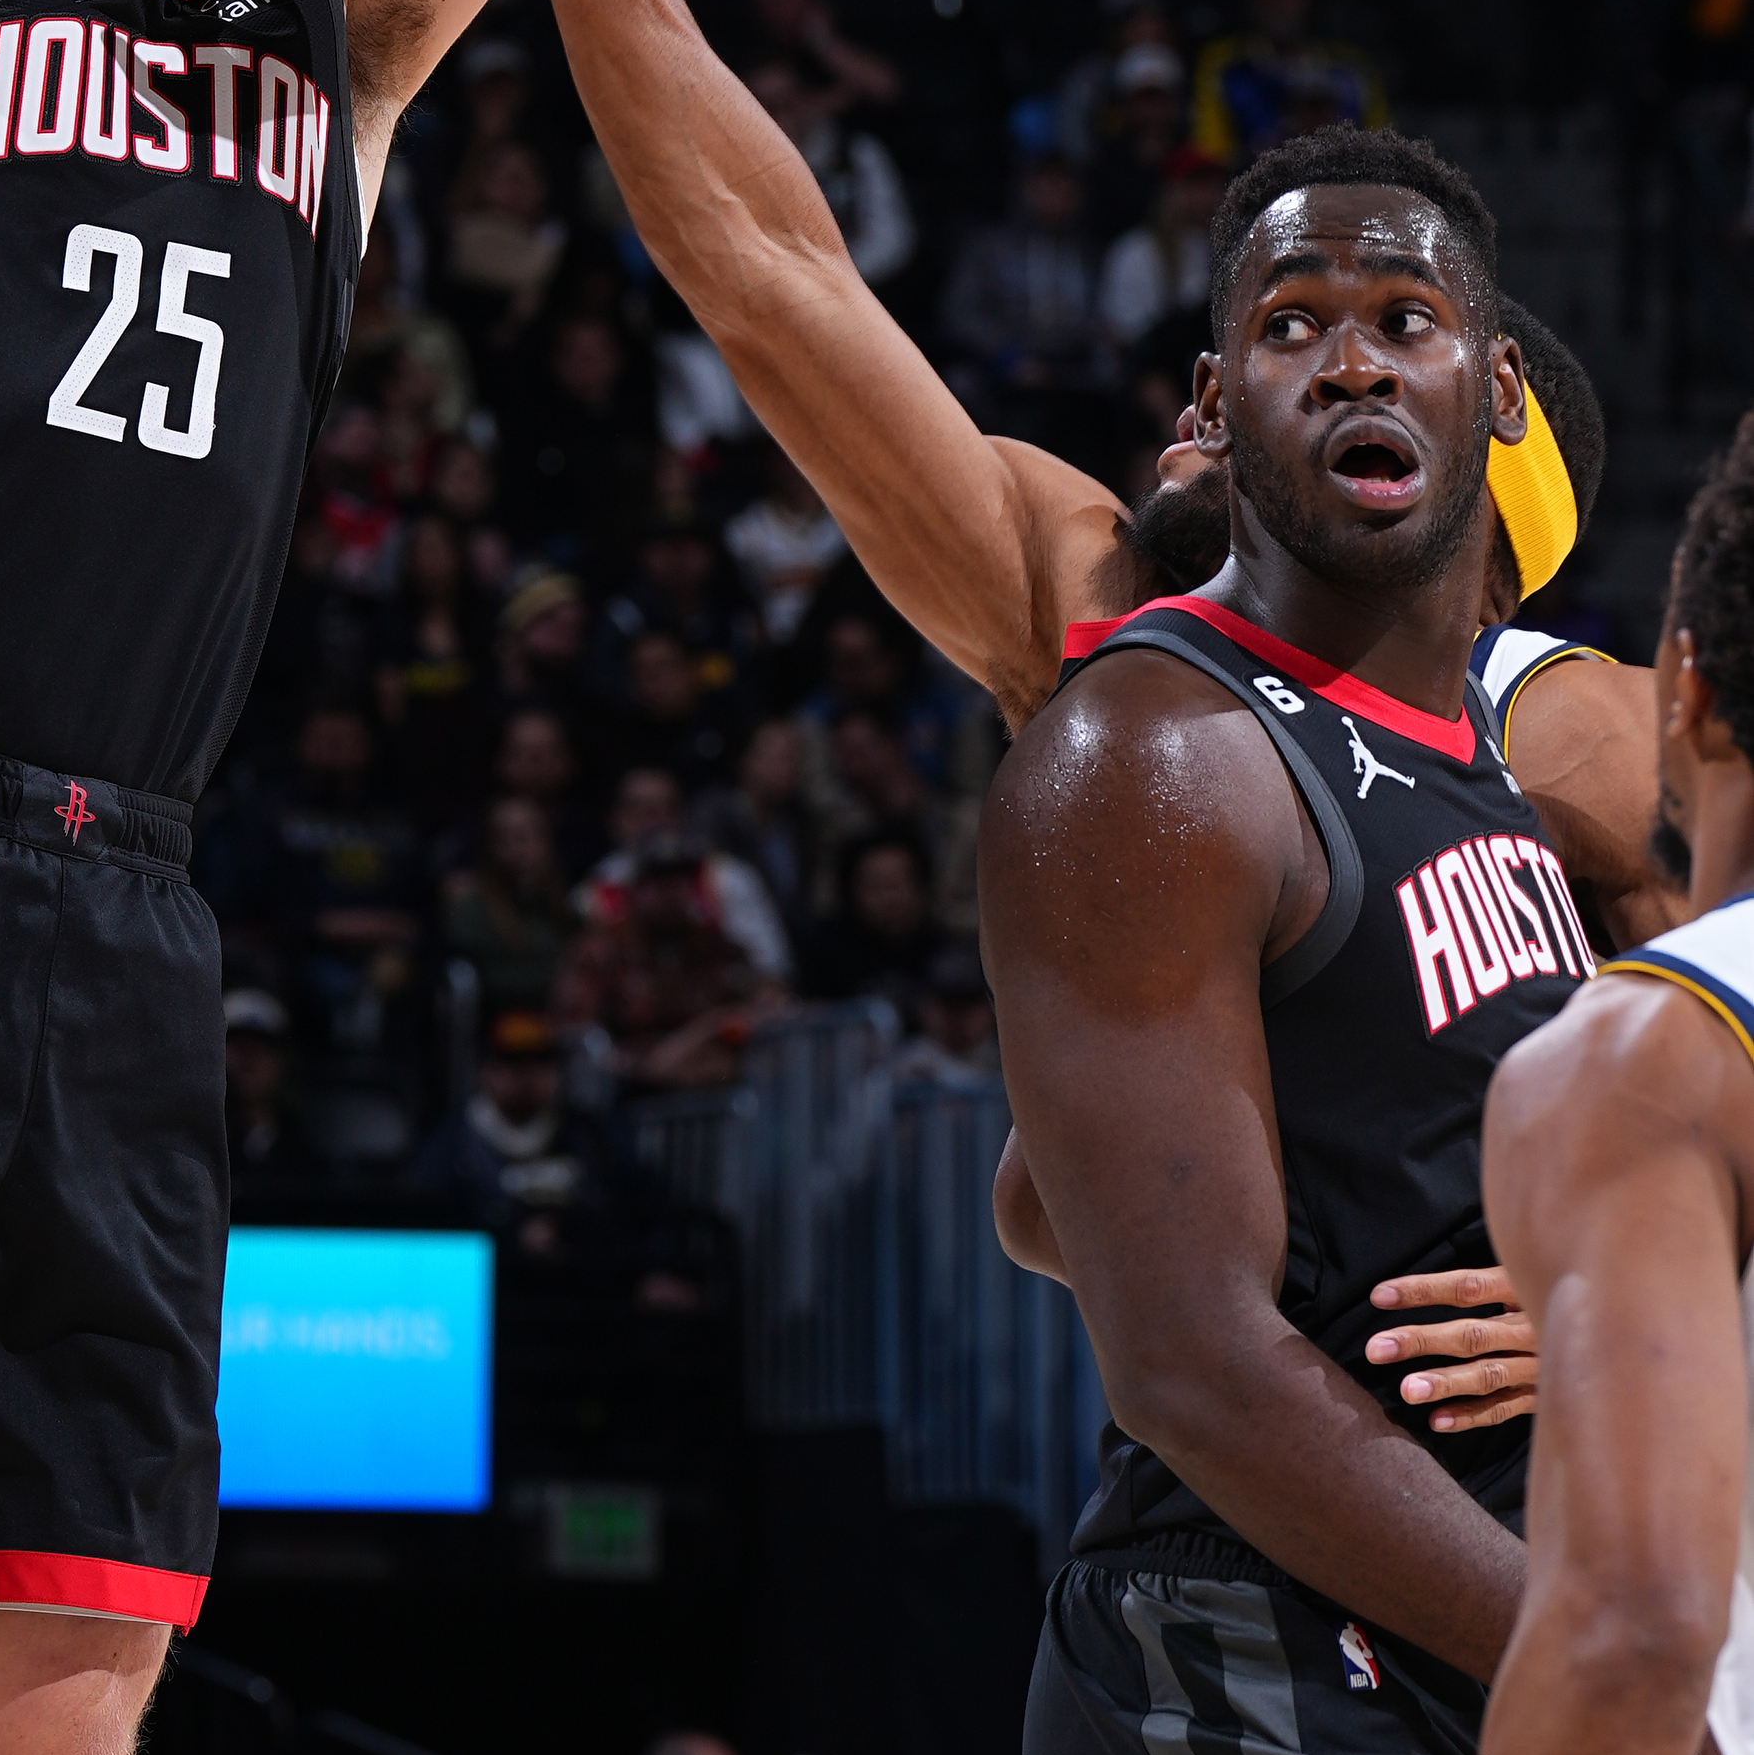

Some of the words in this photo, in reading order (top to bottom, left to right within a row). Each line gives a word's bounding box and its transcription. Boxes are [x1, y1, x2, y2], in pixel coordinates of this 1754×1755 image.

[47, 223, 231, 460] 25
[1253, 675, 1306, 715] 6
[1349, 1672, 1369, 1689] NBA
